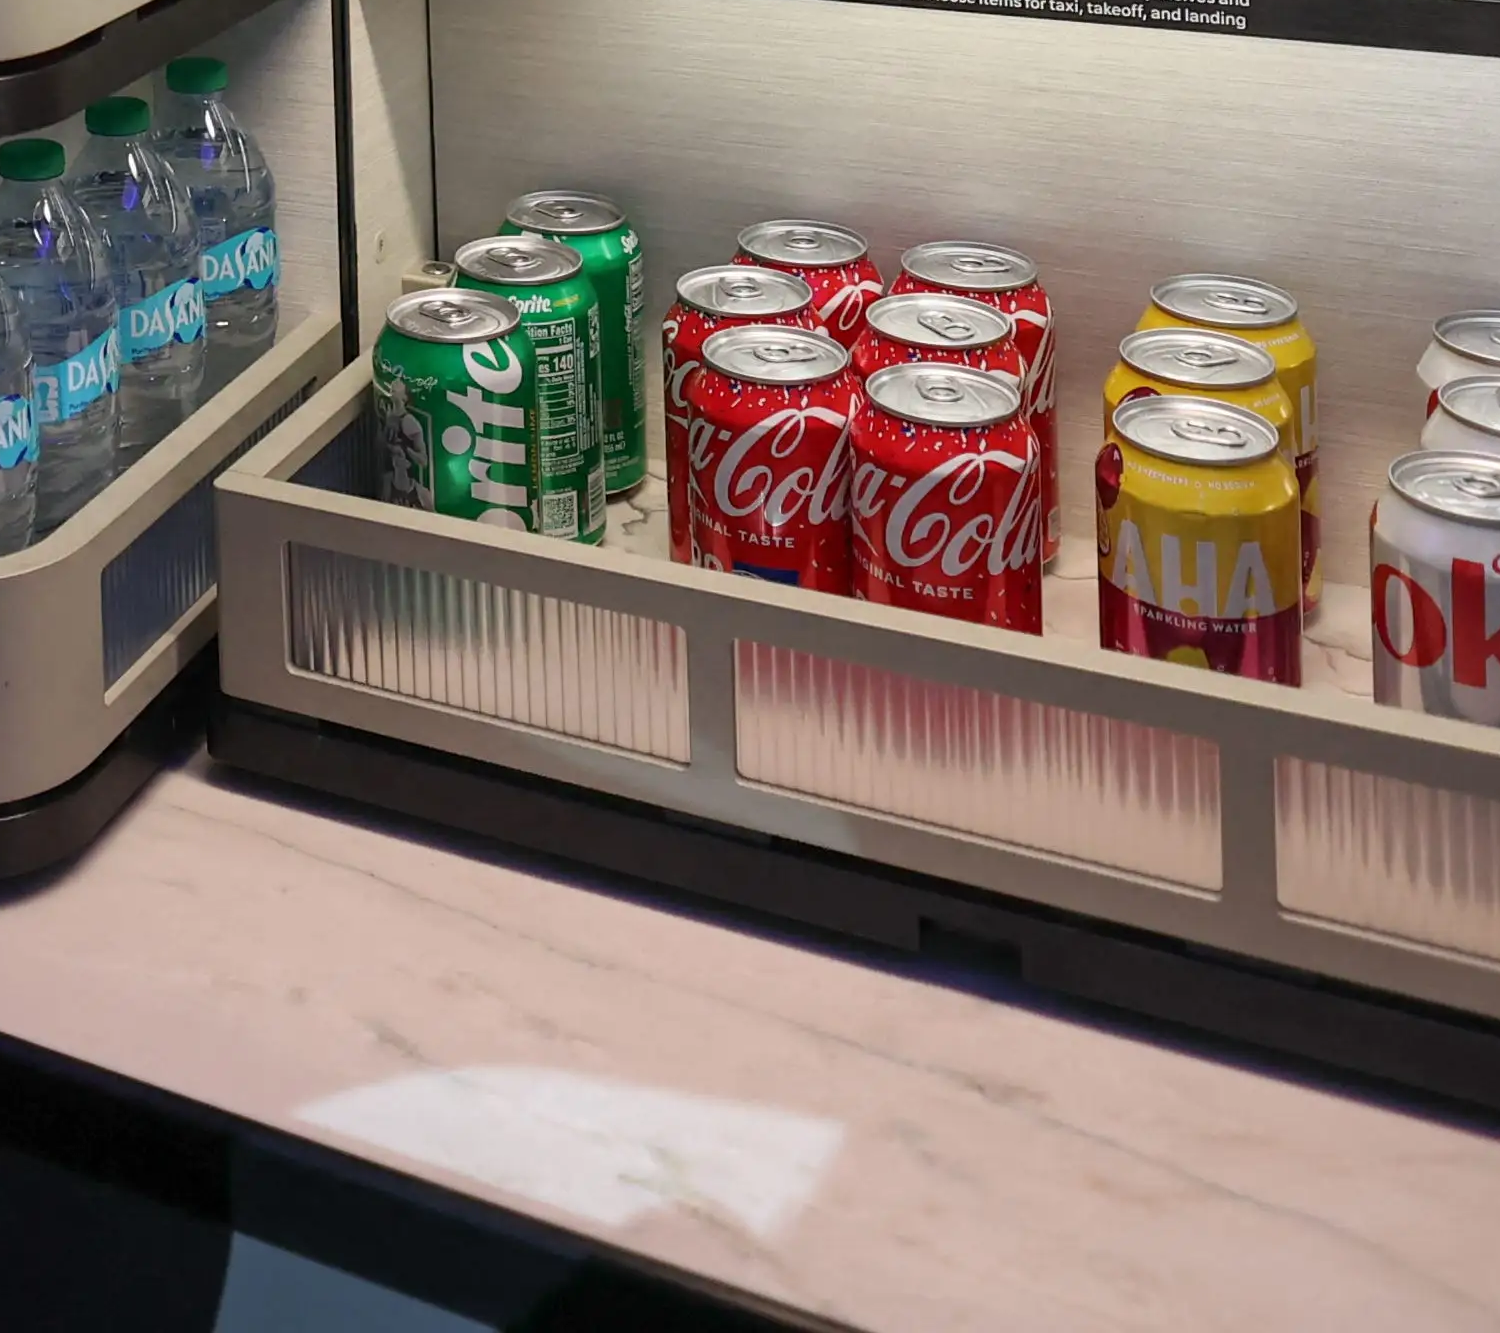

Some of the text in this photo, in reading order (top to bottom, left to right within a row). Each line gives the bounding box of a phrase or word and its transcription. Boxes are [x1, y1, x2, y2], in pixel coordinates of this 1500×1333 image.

[1049, 0, 1084, 17] taxi,
[1087, 3, 1147, 21] takeoff,
[1150, 6, 1182, 21] and
[1185, 10, 1247, 29] landing
[508, 294, 553, 315] Sprite
[550, 322, 573, 336] Facts
[553, 353, 574, 372] 140
[738, 530, 796, 550] TASTE
[1111, 517, 1277, 618] AHA
[912, 580, 974, 601] TASTE
[1133, 602, 1257, 634] SPARKLING WATER
